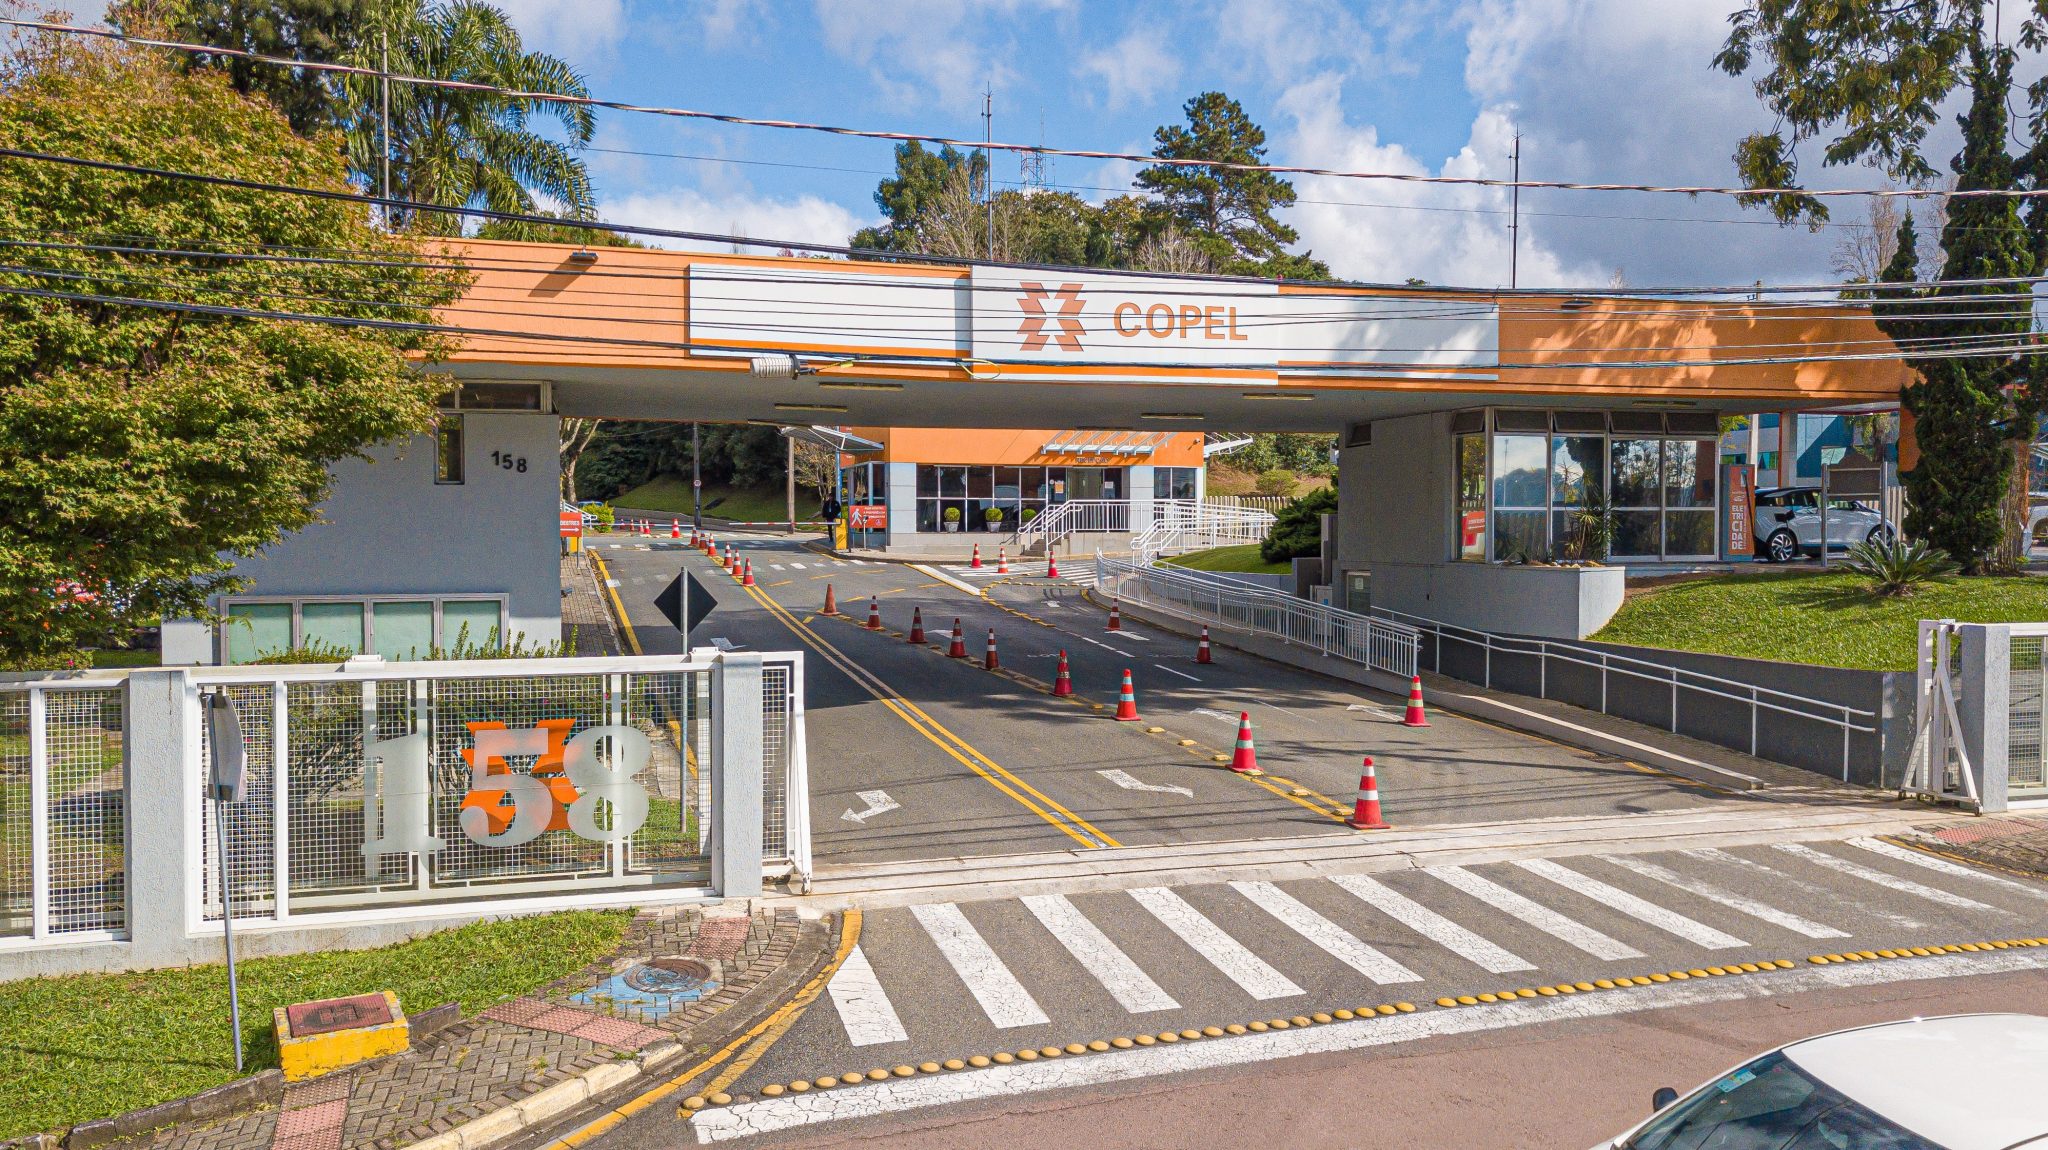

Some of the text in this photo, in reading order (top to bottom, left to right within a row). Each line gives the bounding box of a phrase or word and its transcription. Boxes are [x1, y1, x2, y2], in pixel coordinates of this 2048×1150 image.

[1114, 302, 1248, 341] COPEL
[491, 451, 527, 473] 158
[1731, 521, 1743, 532] CI
[1731, 533, 1744, 541] DA
[361, 725, 651, 855] 158
